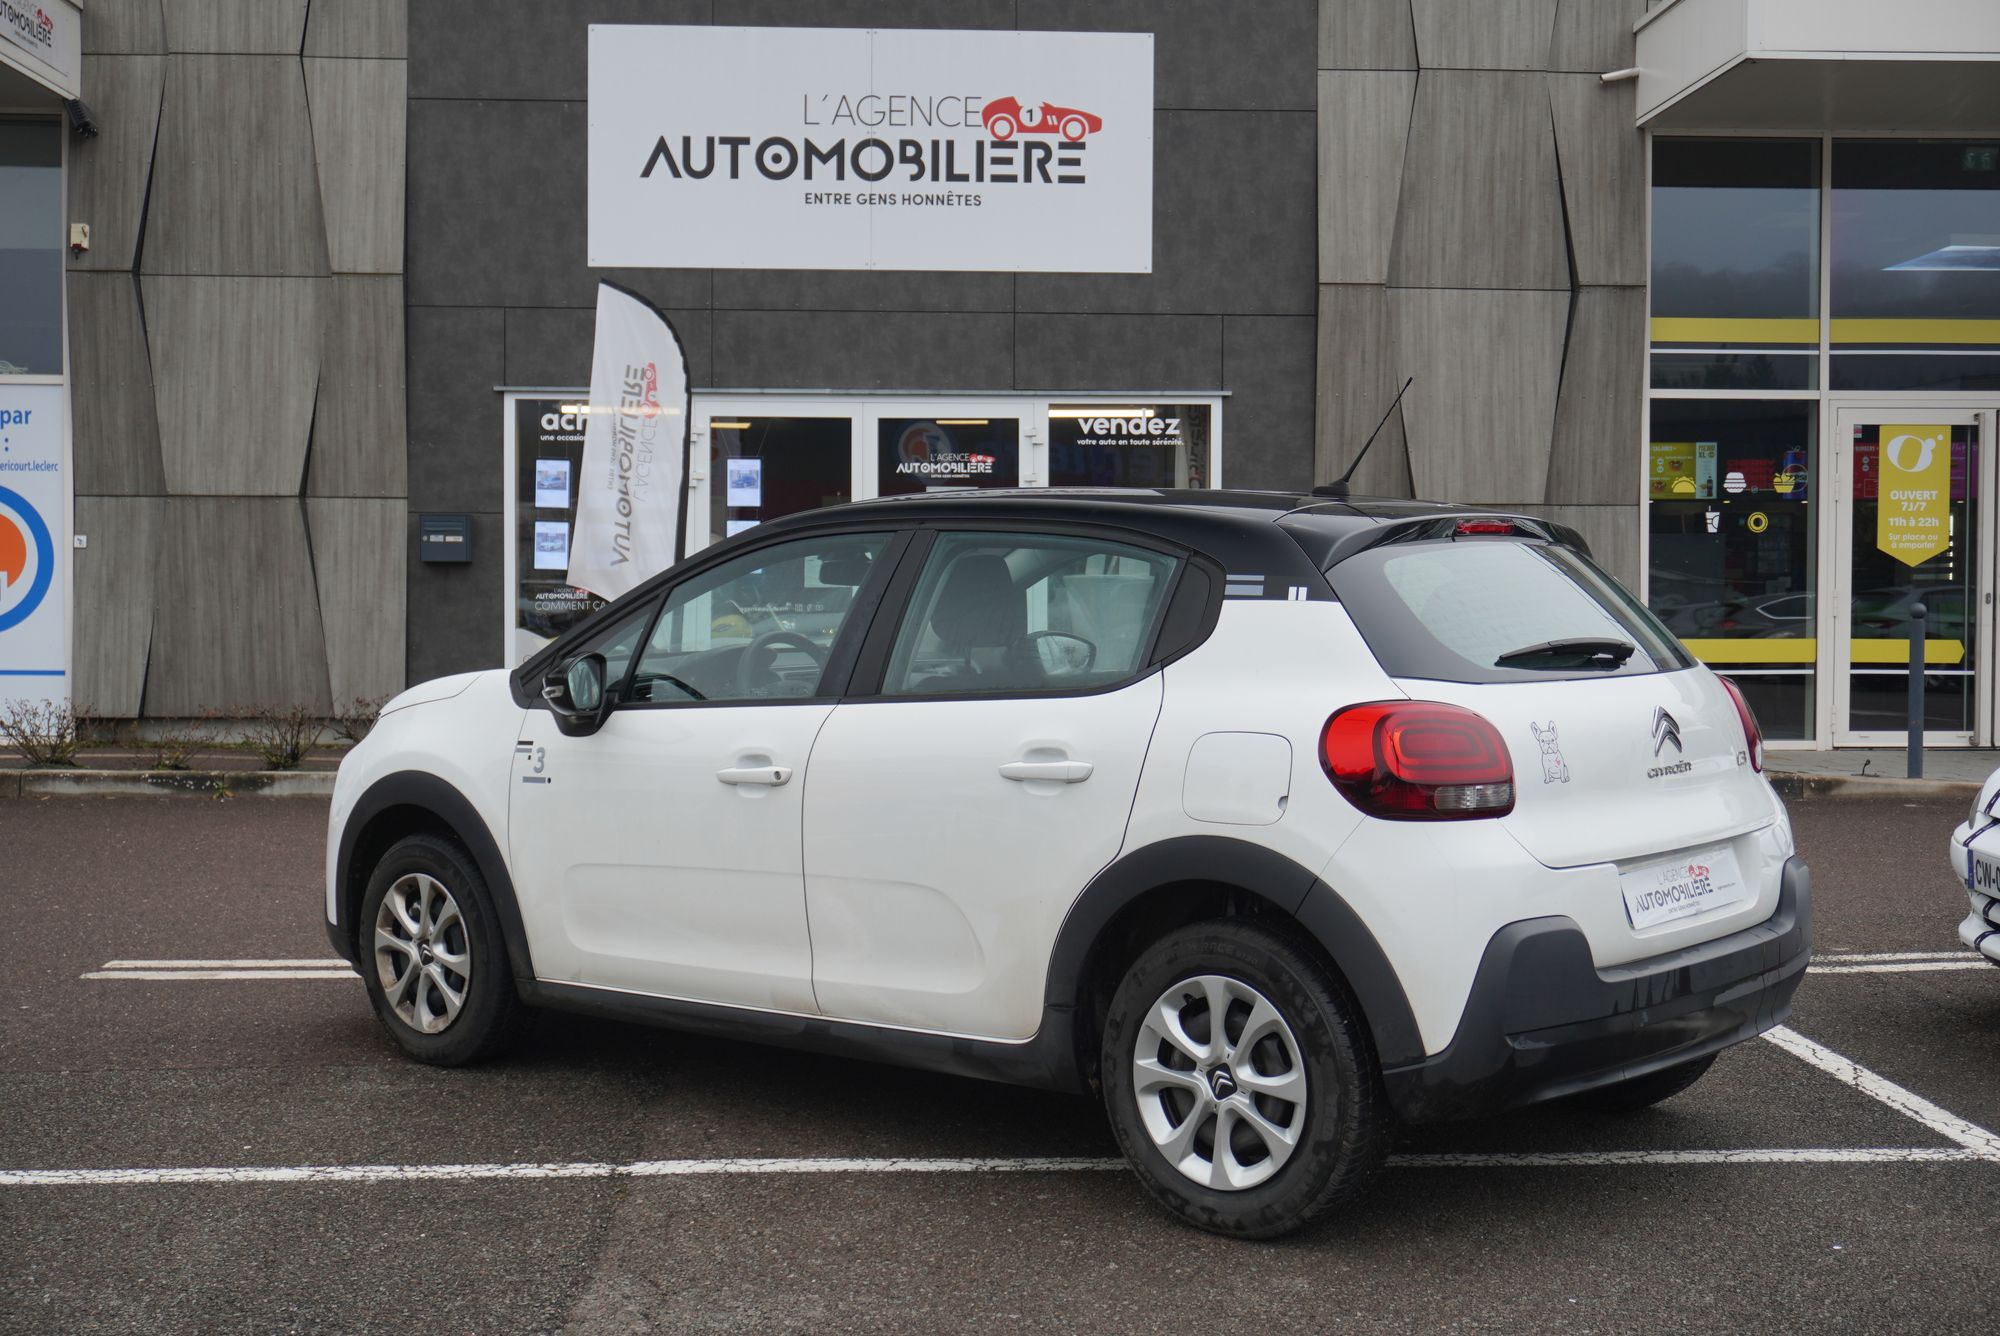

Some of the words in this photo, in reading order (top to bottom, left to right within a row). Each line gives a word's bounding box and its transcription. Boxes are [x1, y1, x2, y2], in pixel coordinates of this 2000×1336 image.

[804, 94, 983, 128] L'AGENCE
[1025, 108, 1034, 122] 1
[804, 193, 852, 206] ENTRE
[856, 193, 898, 206] GENS
[901, 191, 983, 207] HONNÊTES
[0, 409, 32, 430] par
[1077, 408, 1181, 435] vendez
[1076, 438, 1097, 446] votre
[1098, 438, 1117, 446] auto
[1129, 438, 1151, 446] toute
[1890, 490, 1938, 500] OUVERT
[1888, 517, 1907, 527] 11h
[1909, 516, 1916, 527] à
[1918, 517, 1939, 527] 22h
[1888, 532, 1901, 541] Sur
[1902, 532, 1926, 543] place
[1899, 542, 1936, 551] emporter
[534, 601, 591, 611] COMMENT
